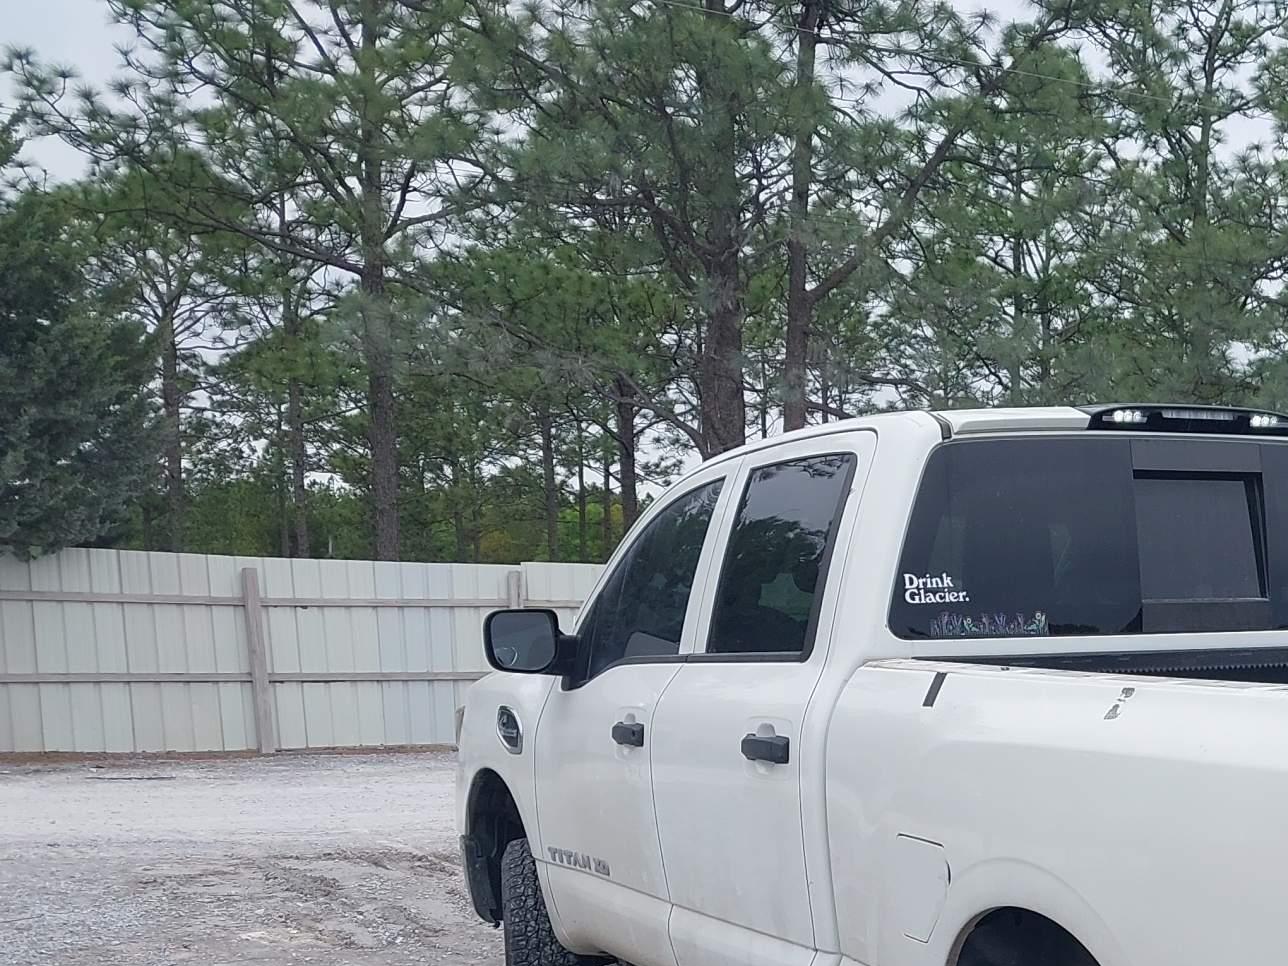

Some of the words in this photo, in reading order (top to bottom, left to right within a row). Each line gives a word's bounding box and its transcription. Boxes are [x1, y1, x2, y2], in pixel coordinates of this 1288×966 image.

[903, 572, 954, 589] Drink
[904, 588, 970, 604] Glacier.
[547, 845, 592, 871] TITAN
